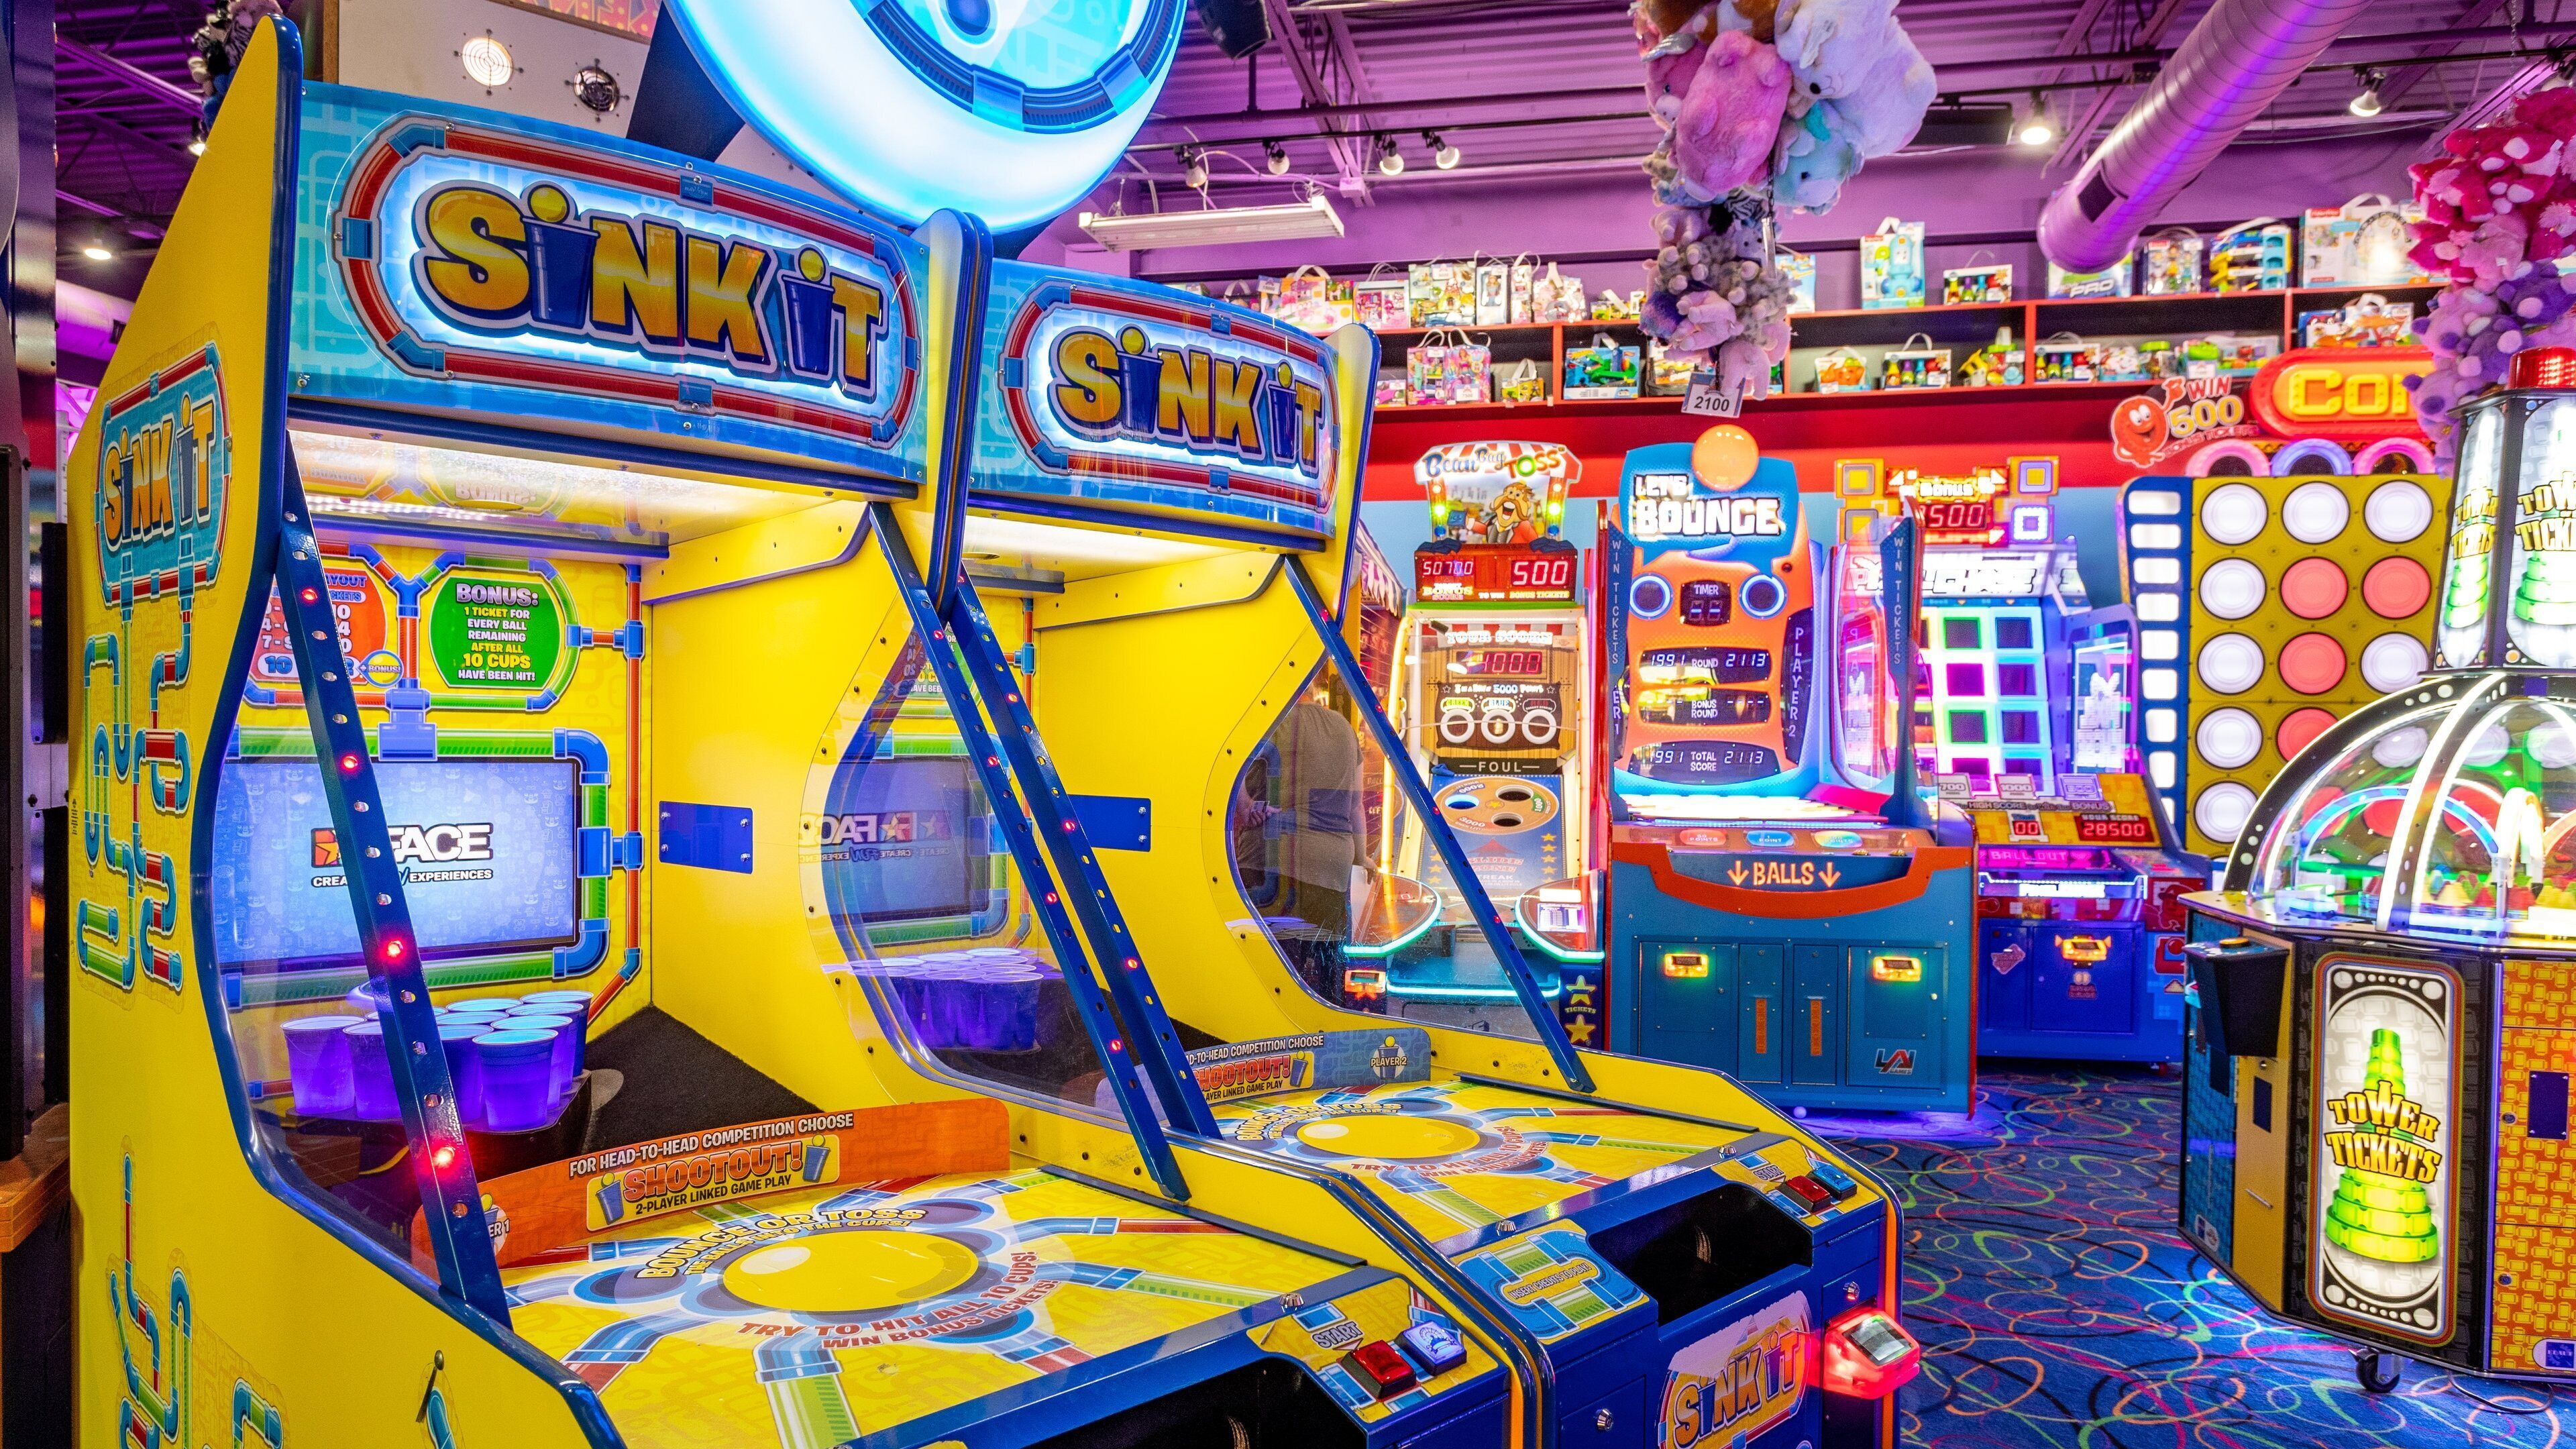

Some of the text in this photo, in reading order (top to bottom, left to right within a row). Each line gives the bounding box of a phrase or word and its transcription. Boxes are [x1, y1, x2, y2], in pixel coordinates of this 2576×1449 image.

[2070, 278, 2114, 299] PRO
[2186, 376, 2232, 401] WIN
[1694, 396, 1730, 411] 2100
[2168, 396, 2243, 438] 500
[1423, 447, 1560, 478] Bean Bag TOSS
[1634, 474, 1690, 496] LET'S
[1635, 498, 1783, 535] BOUNCE
[1423, 561, 1473, 576] 50700
[1513, 561, 1568, 585] 500
[456, 583, 539, 606] BONUS:
[1694, 584, 1719, 596] TIMER
[1611, 540, 1621, 664] WIN TICKETS
[1893, 537, 1903, 664] WIN TICKETS
[464, 606, 530, 619] 1 TICKET FOR
[468, 619, 527, 631] EVERY BALL
[468, 631, 527, 642] REMAINING
[472, 643, 523, 653] AFTER ALL
[265, 656, 292, 673] 10
[369, 665, 401, 674] BONUS!
[463, 653, 531, 669] 10 CUPS
[1651, 653, 1766, 667] 1991 ROUND 2113
[458, 669, 535, 681] HAVE BEEN HIT!
[1788, 627, 1804, 737] PLAYER 2
[1493, 684, 1518, 694] 5000
[1692, 700, 1717, 708] BONUS
[1691, 710, 1717, 718] ROUND
[1478, 761, 1521, 772] FOUL
[1690, 752, 1717, 762] TOTAL
[1724, 751, 1764, 763] 2113
[1690, 761, 1717, 771] SCORE
[2015, 822, 2039, 835] 00
[2082, 822, 2146, 837] 28500
[1990, 851, 2068, 860] BALL OUT
[409, 869, 492, 883] EXPERIENCES
[1752, 862, 1815, 885] BALLS
[1564, 1006, 1596, 1014] TICKETS
[1230, 1035, 1324, 1058] COMPETITION CHOOSE
[1371, 1056, 1407, 1067] PLAYER 2
[1222, 1079, 1283, 1098] LINKED GAME PLAY
[2327, 1080, 2440, 1142] TOWER
[569, 1112, 854, 1178] FOR HEAD-TO-HEAD COMPETITION CHOOSE
[1351, 1163, 1397, 1172] TRY
[1404, 1163, 1439, 1171] TO
[1440, 1159, 1478, 1169] HIT
[1474, 1151, 1511, 1166] ALL
[2325, 1131, 2443, 1185] TICKETS
[623, 1141, 804, 1205] SHOOTOUT!
[1753, 1165, 1784, 1181] START
[635, 1173, 791, 1216] 2-PLAYER LINKED GAME PLAY
[634, 1208, 928, 1279] BOUNCE OR TOSS
[684, 1218, 910, 1276] THE BALLS INTO THE CUPS!
[1508, 1263, 1593, 1299] INSERT CREDITS TO PLAY!
[735, 1251, 1038, 1338] TRY TO HIT ALL 10 CUPS!
[822, 1279, 1060, 1348] WIN BONUS TICKETS!
[1315, 1322, 1362, 1348] START
